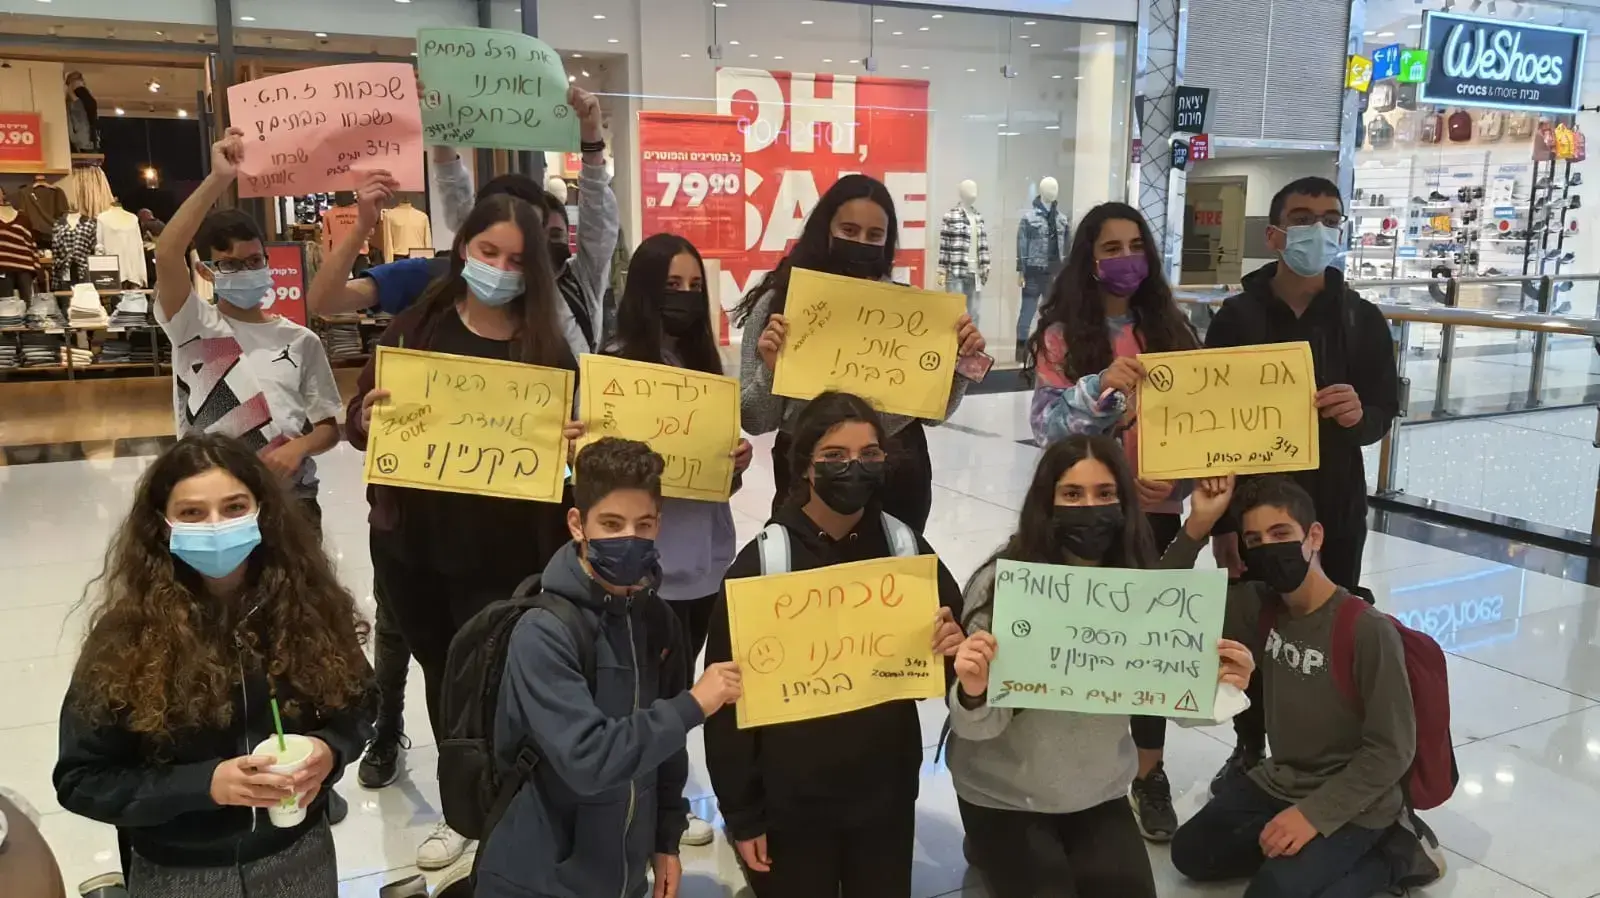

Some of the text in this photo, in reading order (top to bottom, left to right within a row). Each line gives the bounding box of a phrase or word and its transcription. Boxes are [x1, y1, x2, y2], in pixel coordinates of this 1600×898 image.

[424, 38, 553, 64] את הכל פתחתם
[1444, 24, 1563, 85] WeShoes
[334, 76, 404, 100] שכבות
[468, 73, 542, 98] ואותנו
[1457, 83, 1487, 96] crocs
[1494, 87, 1518, 99] more
[1520, 90, 1539, 100] מבית
[447, 94, 541, 128] שכחתם!
[716, 67, 868, 163] OH,
[1178, 95, 1204, 110] יציאת
[255, 108, 393, 141] נשכחו בבתים!
[1178, 112, 1201, 126] חירום
[271, 148, 309, 166] שכחו
[366, 139, 400, 156] 347
[730, 152, 742, 162] כל
[1195, 211, 1222, 225] FIRE
[857, 306, 928, 337] שכחו
[856, 337, 910, 361] אותי
[830, 349, 906, 386] בבית!
[1186, 361, 1296, 396] גם אני
[425, 370, 552, 407] הוד השרון
[634, 376, 707, 402] ילדים
[449, 412, 531, 437] לומדת
[648, 409, 699, 440] לפני
[1159, 405, 1282, 447] חשובה!
[1248, 452, 1274, 463] ימים
[1271, 436, 1299, 458] 347
[774, 573, 904, 620] שכחתם
[997, 567, 1204, 623] אם לא לומדים
[1065, 626, 1204, 653] מבית הספר
[808, 632, 897, 677] אותנו
[904, 657, 928, 669] 347
[1050, 646, 1201, 679] לומדים בקניון!
[782, 672, 853, 702] בבית!
[1086, 688, 1122, 705] ימים
[1131, 691, 1166, 707] 347
